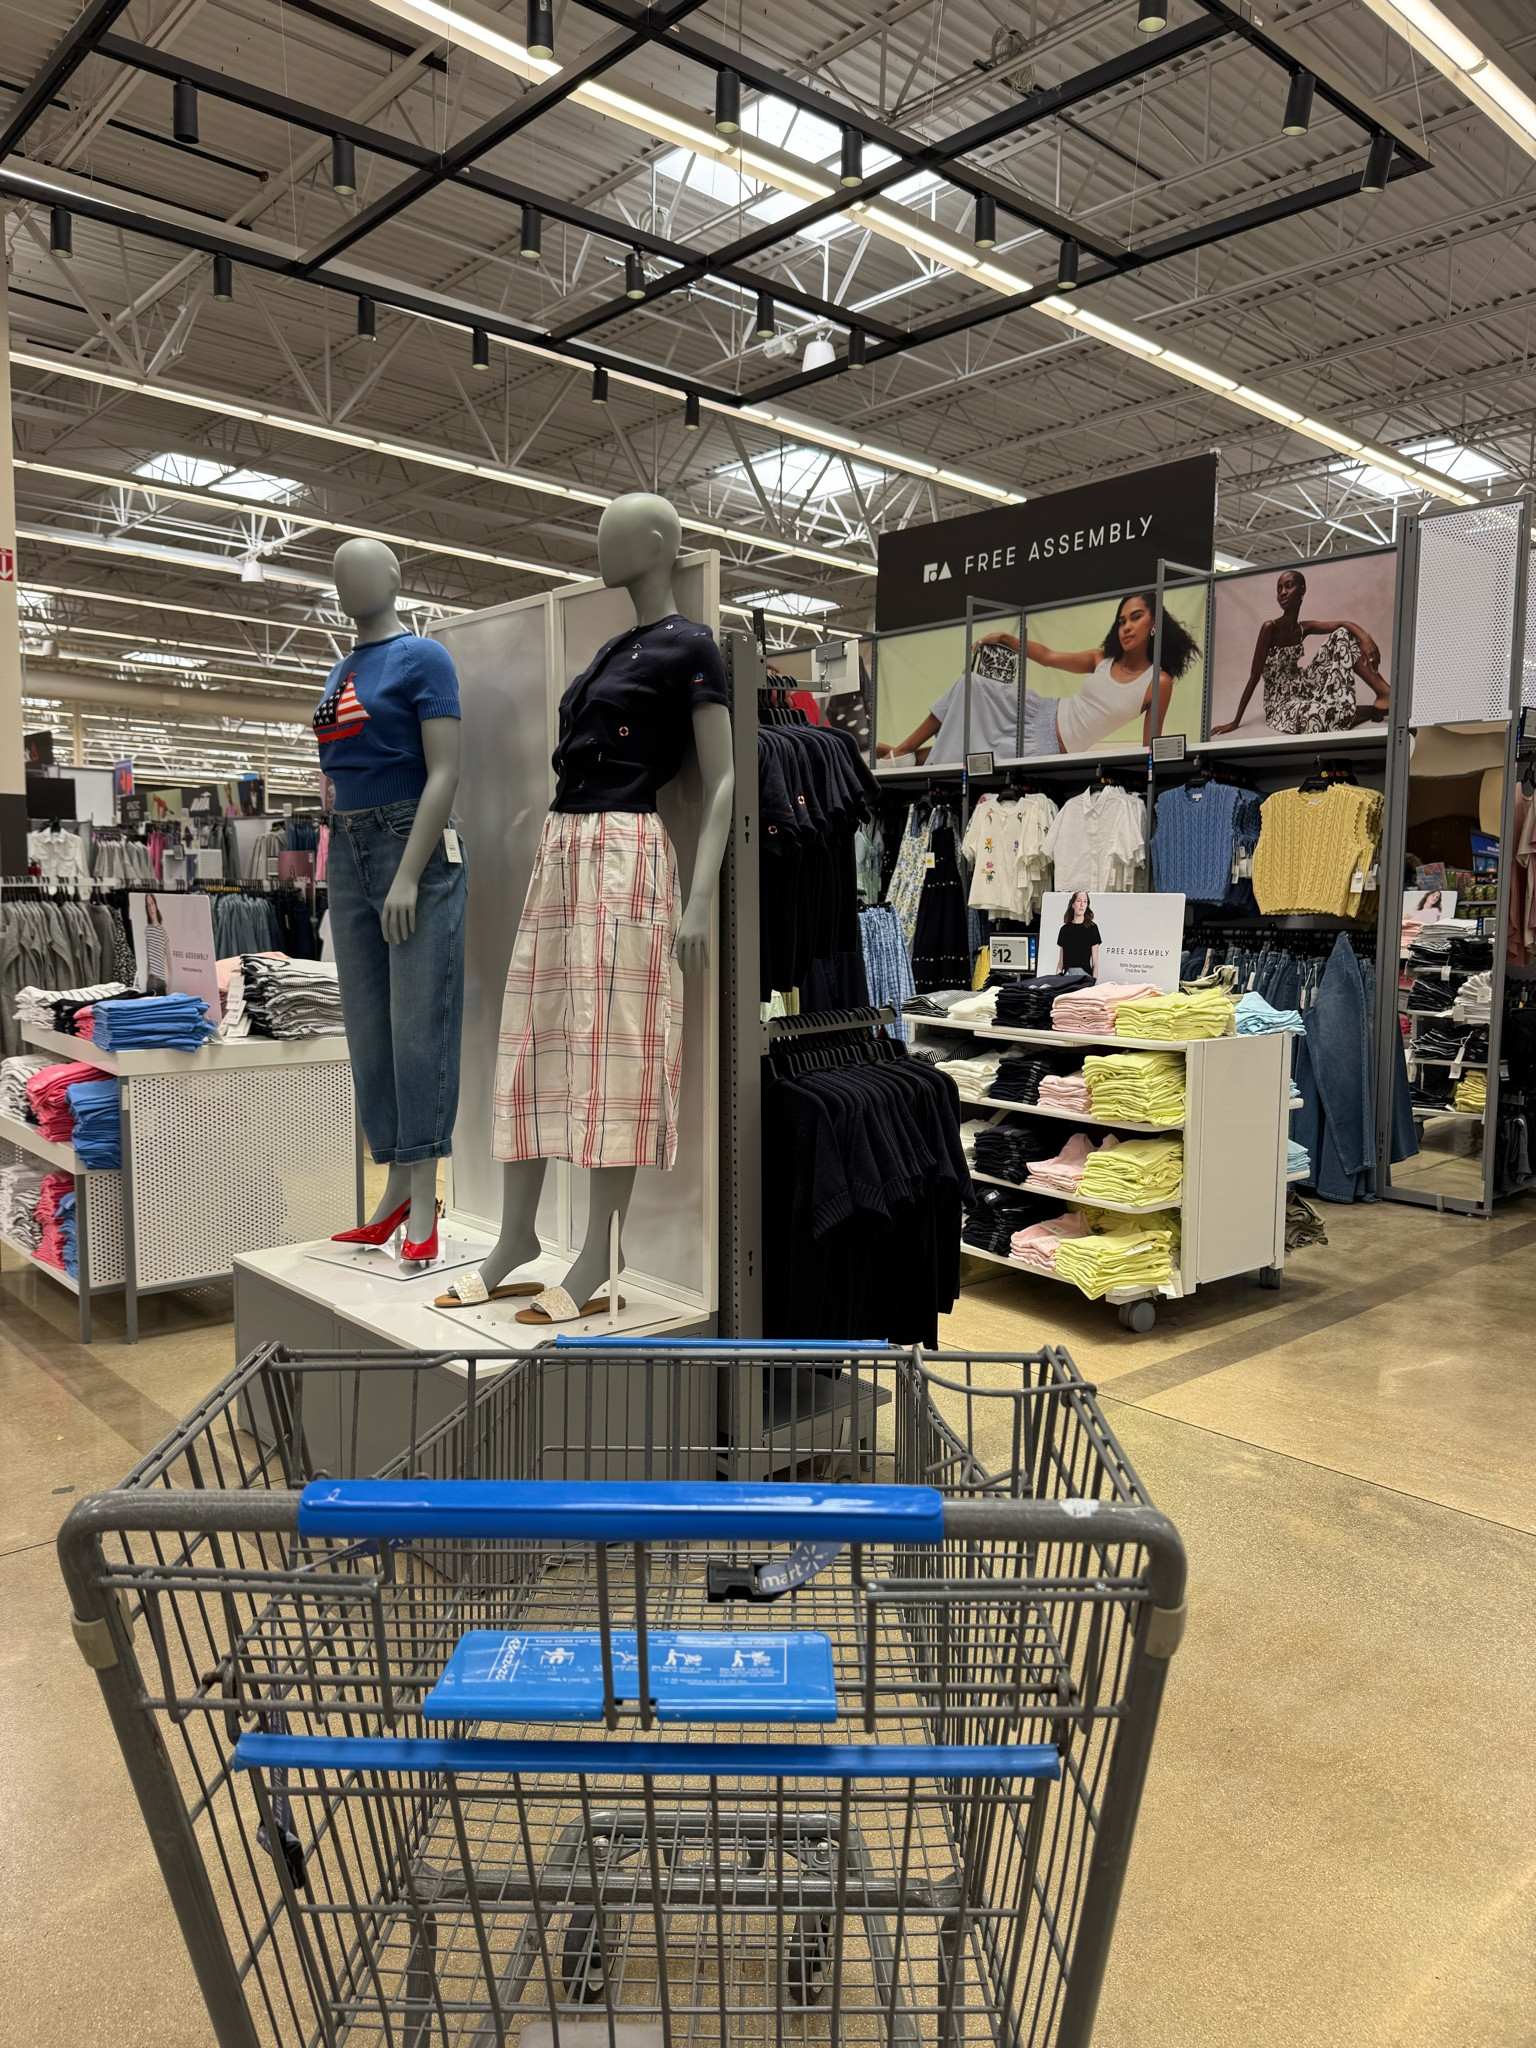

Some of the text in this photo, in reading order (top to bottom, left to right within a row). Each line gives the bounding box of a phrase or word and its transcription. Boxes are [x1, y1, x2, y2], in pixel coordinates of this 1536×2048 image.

[964, 514, 1153, 575] FREE ASSEMBLY
[173, 950, 208, 960] FREE ASSEMBLY
[992, 948, 1012, 964] $12
[1106, 947, 1170, 957] FREE ASSEMBLY
